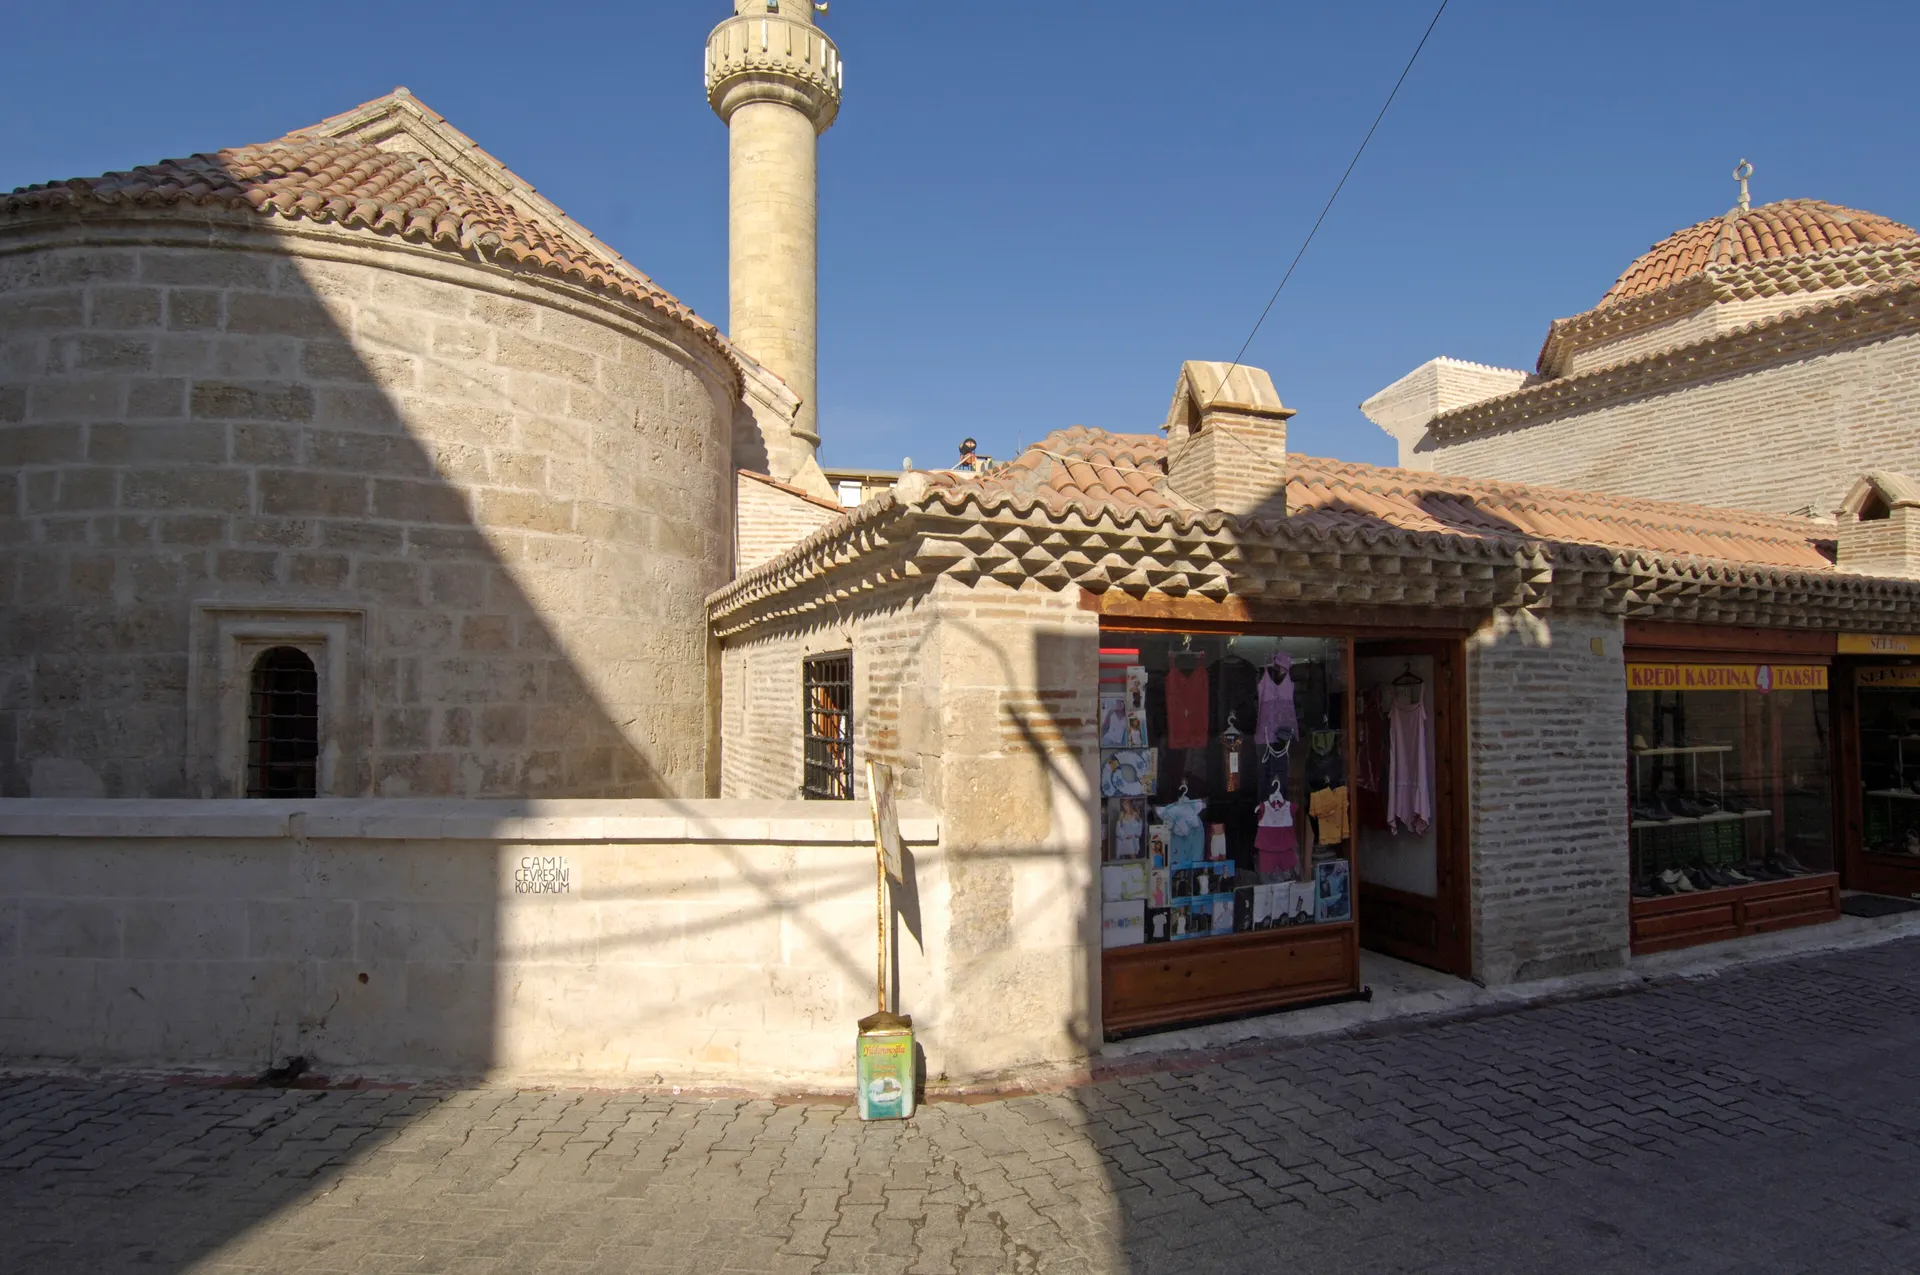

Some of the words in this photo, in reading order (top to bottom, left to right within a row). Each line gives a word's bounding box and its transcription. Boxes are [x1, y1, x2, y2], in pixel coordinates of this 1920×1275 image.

[1632, 665, 1680, 686] KREDİ
[1685, 668, 1751, 686] KARTINA
[1757, 666, 1769, 689] 4
[1776, 666, 1823, 686] TAKSİT
[515, 881, 570, 894] KORUYALIM
